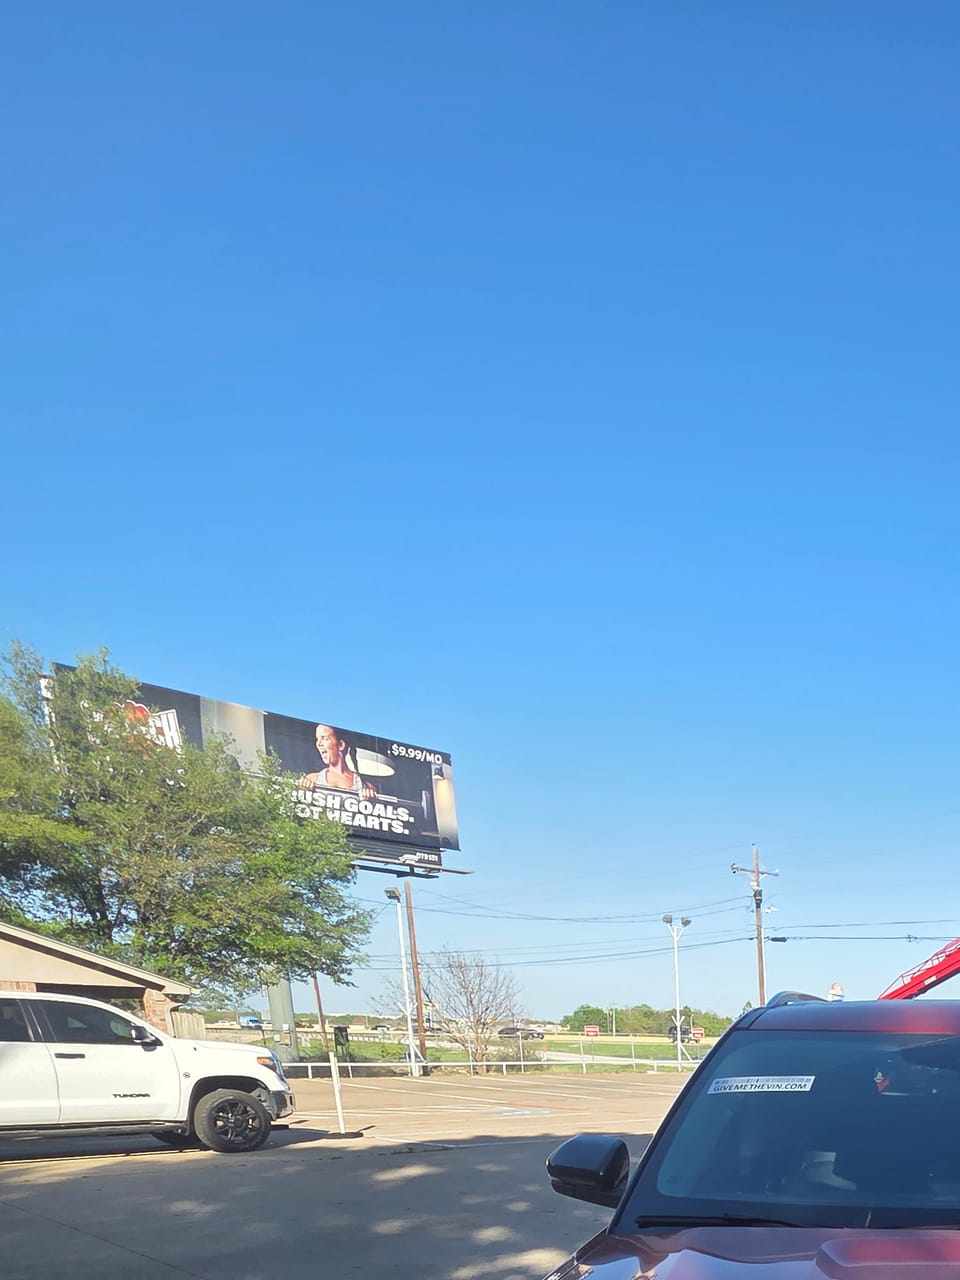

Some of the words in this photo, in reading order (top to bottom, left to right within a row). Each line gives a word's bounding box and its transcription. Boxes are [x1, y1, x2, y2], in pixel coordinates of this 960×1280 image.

[327, 808, 409, 835] HEARTS.
[344, 797, 414, 823] GOALS.
[713, 1083, 807, 1092] GIVEMETHEVIN.COM
